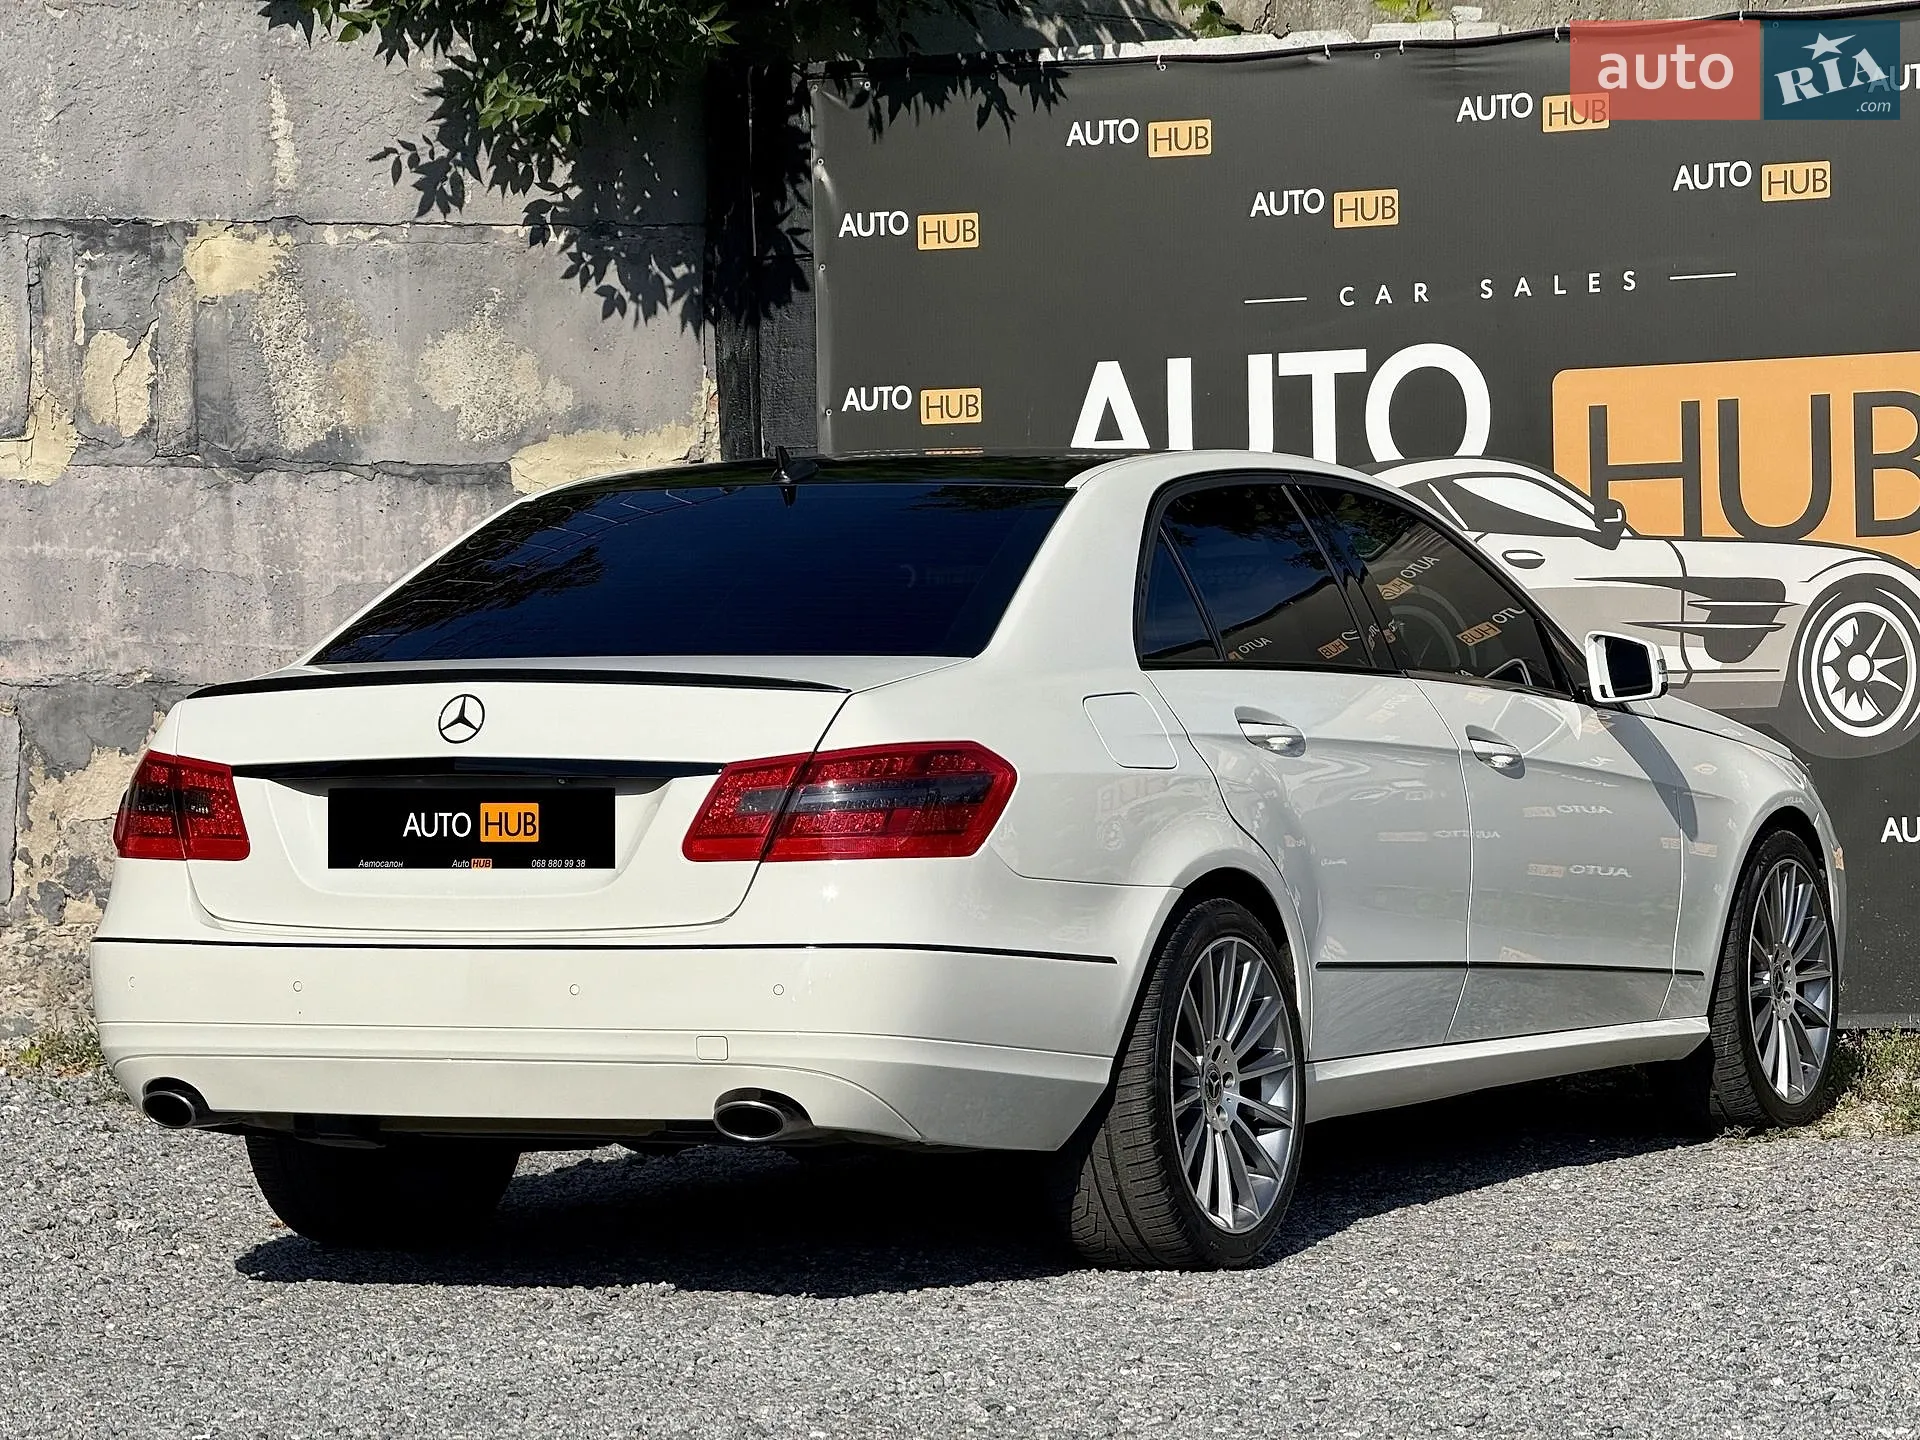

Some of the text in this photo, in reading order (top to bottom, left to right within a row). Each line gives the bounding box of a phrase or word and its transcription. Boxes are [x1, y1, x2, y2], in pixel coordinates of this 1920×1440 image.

[1456, 92, 1608, 127] AUTO HUB
[1065, 118, 1209, 152] AUTO HUB
[1672, 160, 1828, 196] AUTO HUB
[1249, 188, 1396, 223] AUTO HUB
[838, 210, 977, 245] AUTO HUB
[1339, 270, 1637, 306] CAR SALES
[841, 385, 980, 420] AUTO HUB
[1071, 343, 1920, 539] AUTO HUB
